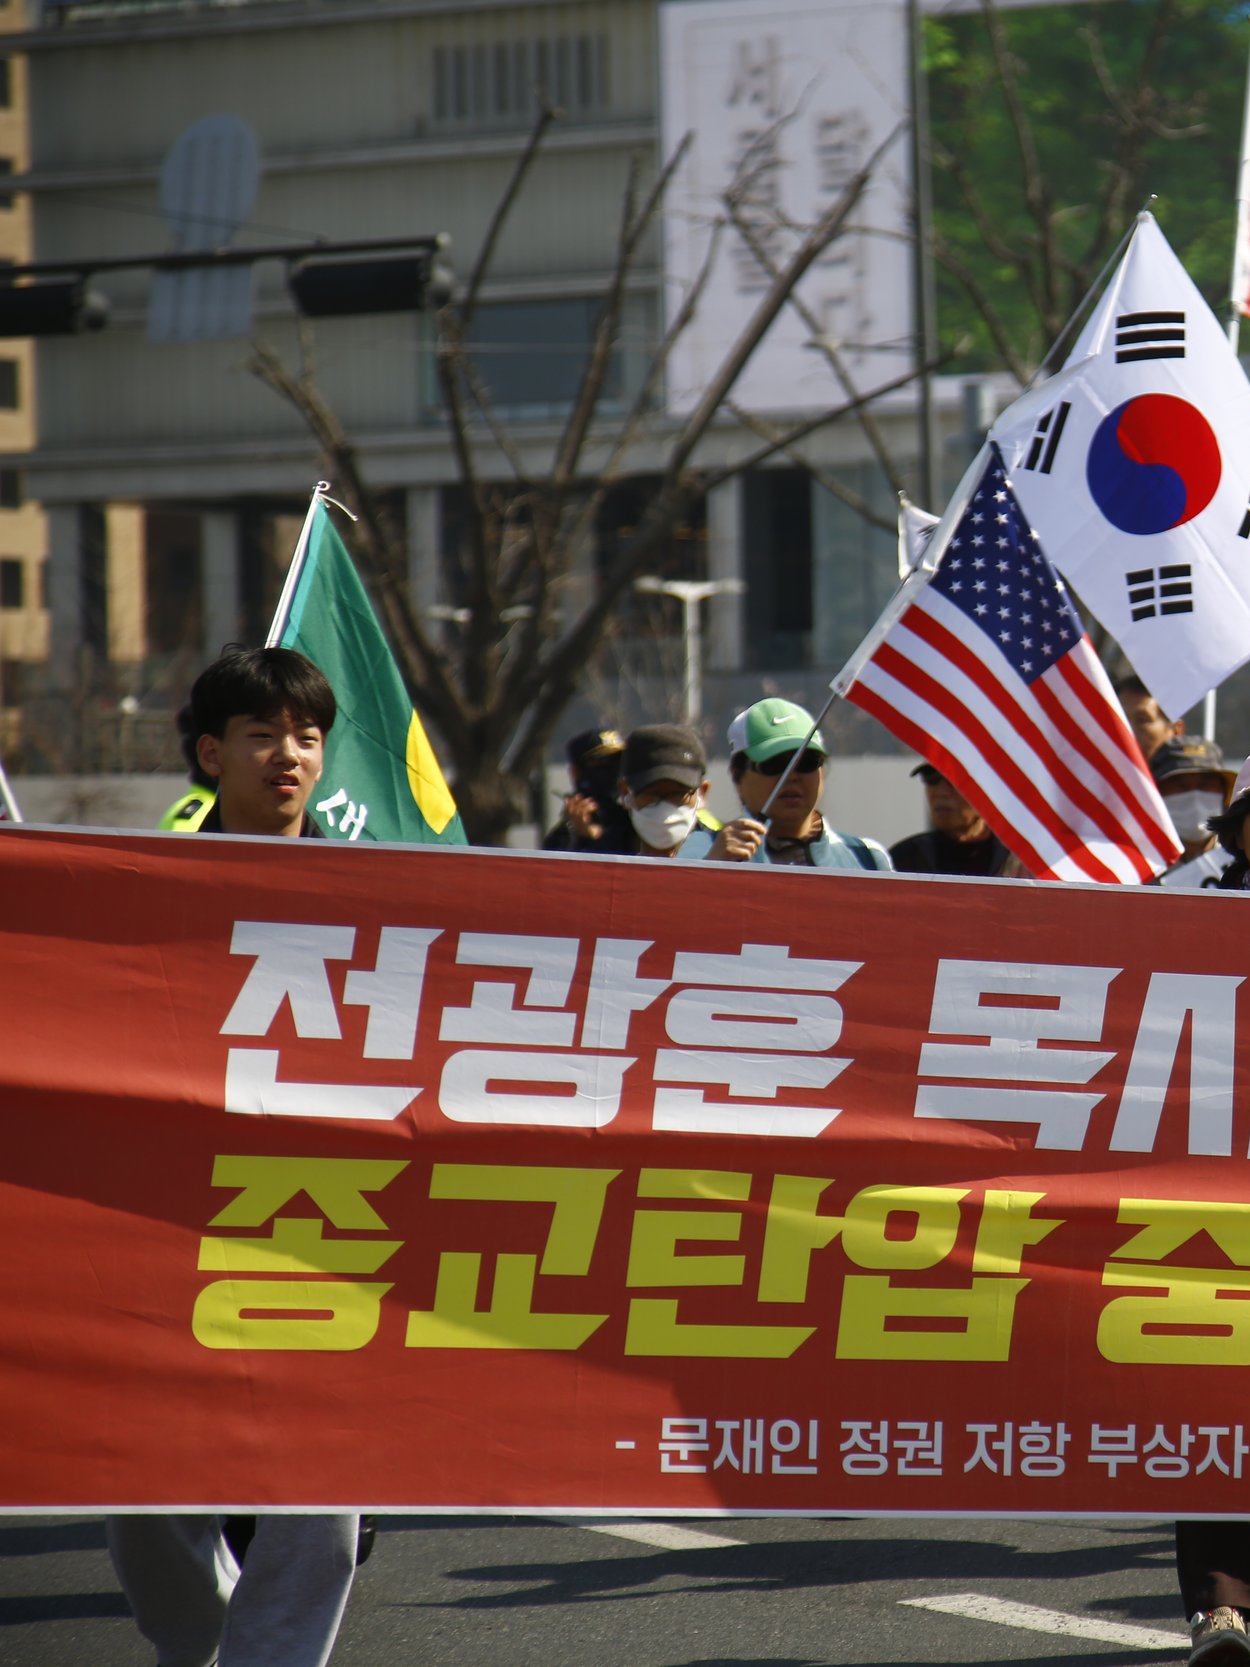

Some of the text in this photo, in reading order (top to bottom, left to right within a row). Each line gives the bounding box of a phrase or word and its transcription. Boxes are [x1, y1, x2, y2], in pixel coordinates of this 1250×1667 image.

[219, 921, 865, 1138] 전광훈
[192, 1155, 1065, 1361] 종교탄압
[658, 1417, 818, 1475] 문재인
[839, 1420, 943, 1476] 정권
[963, 1420, 1072, 1477] 저항
[1087, 1423, 1250, 1479] 부상자
